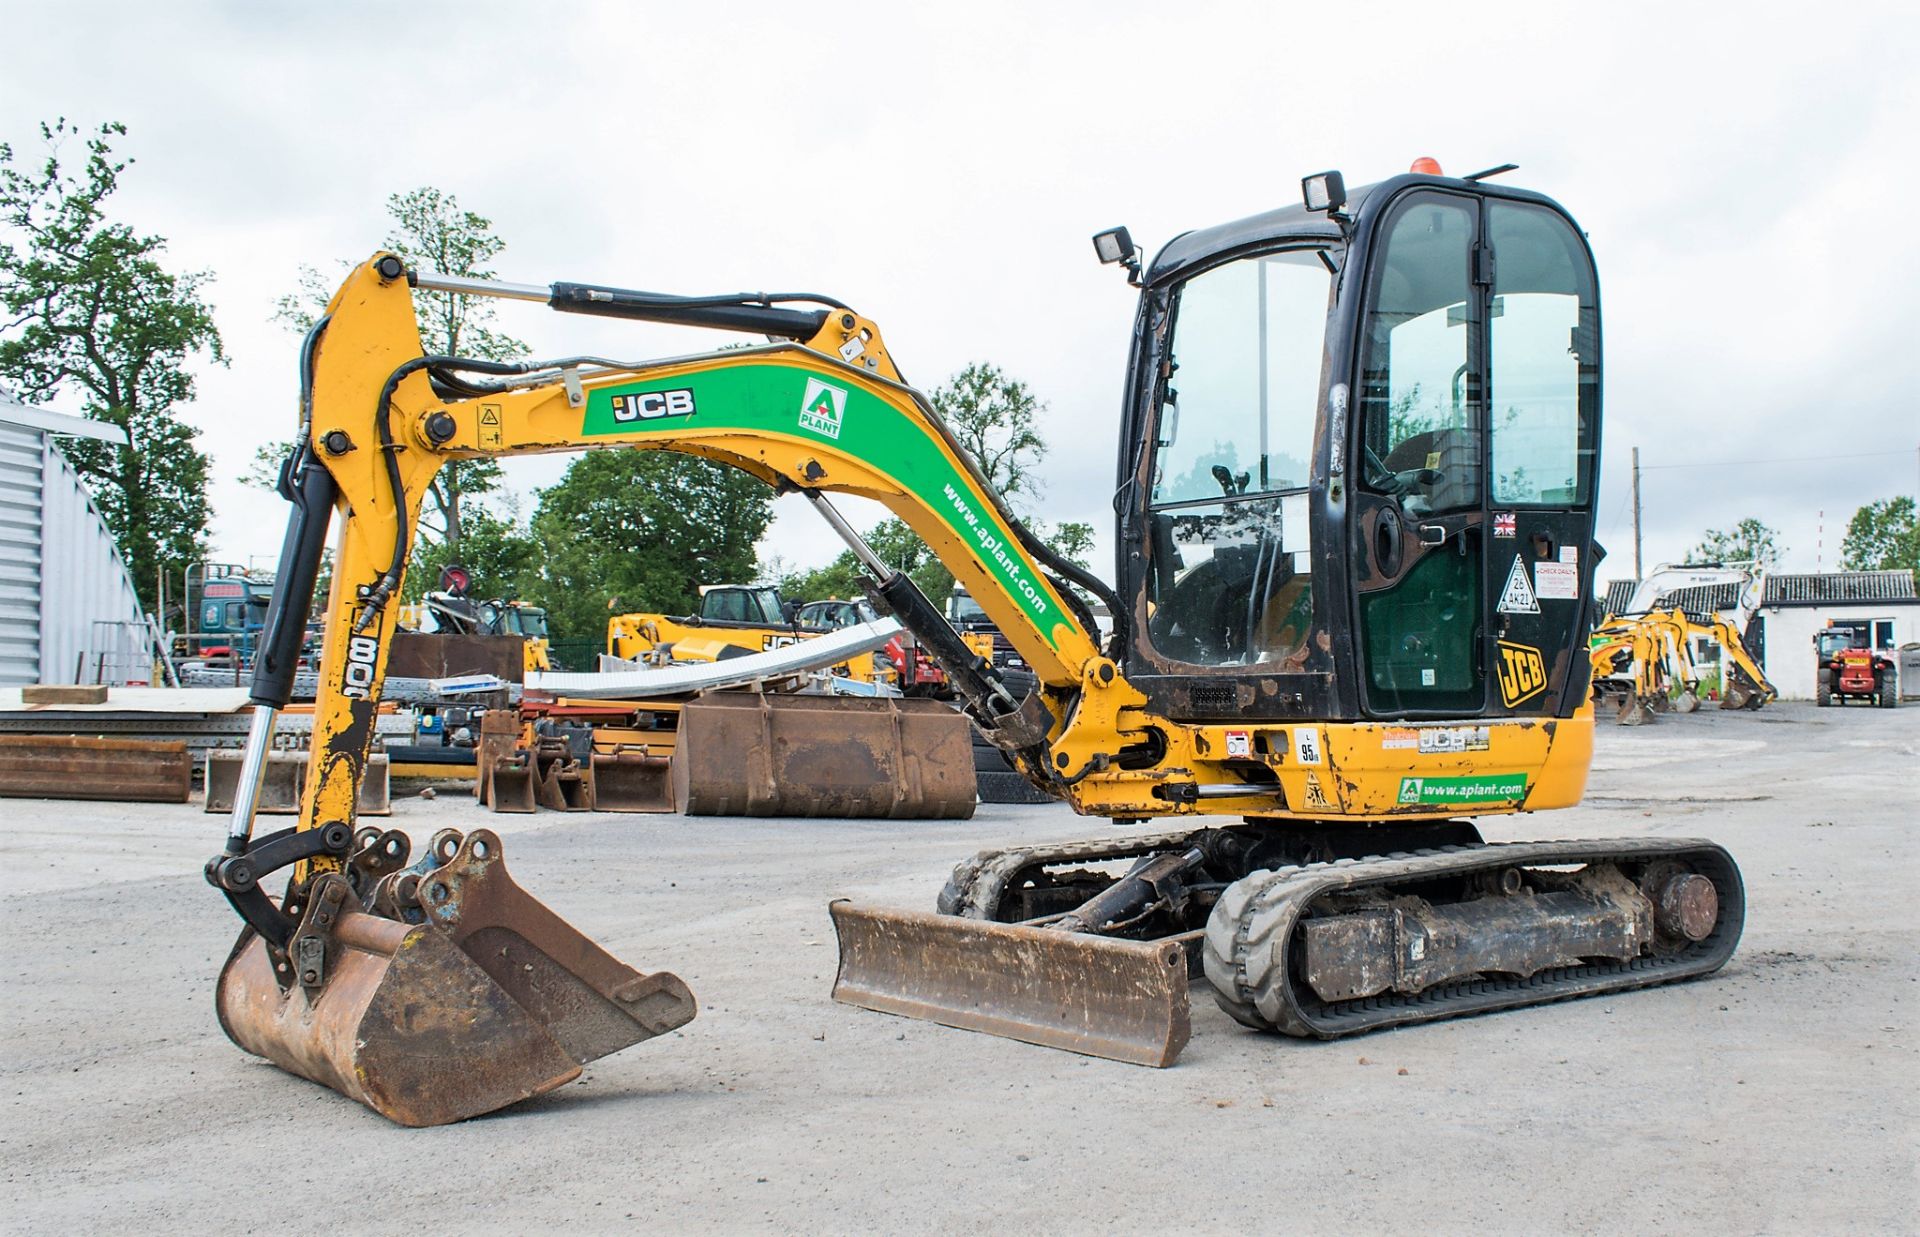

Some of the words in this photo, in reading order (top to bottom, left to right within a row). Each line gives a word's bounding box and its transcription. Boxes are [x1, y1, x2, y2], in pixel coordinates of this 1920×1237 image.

[614, 389, 695, 421] JCB
[800, 412, 839, 437] PLANT
[943, 481, 1049, 614] www.aplant.com
[1513, 577, 1525, 590] 26
[1502, 648, 1543, 700] JCB
[1301, 744, 1314, 762] 95
[1424, 783, 1523, 799] www.aplant.com
